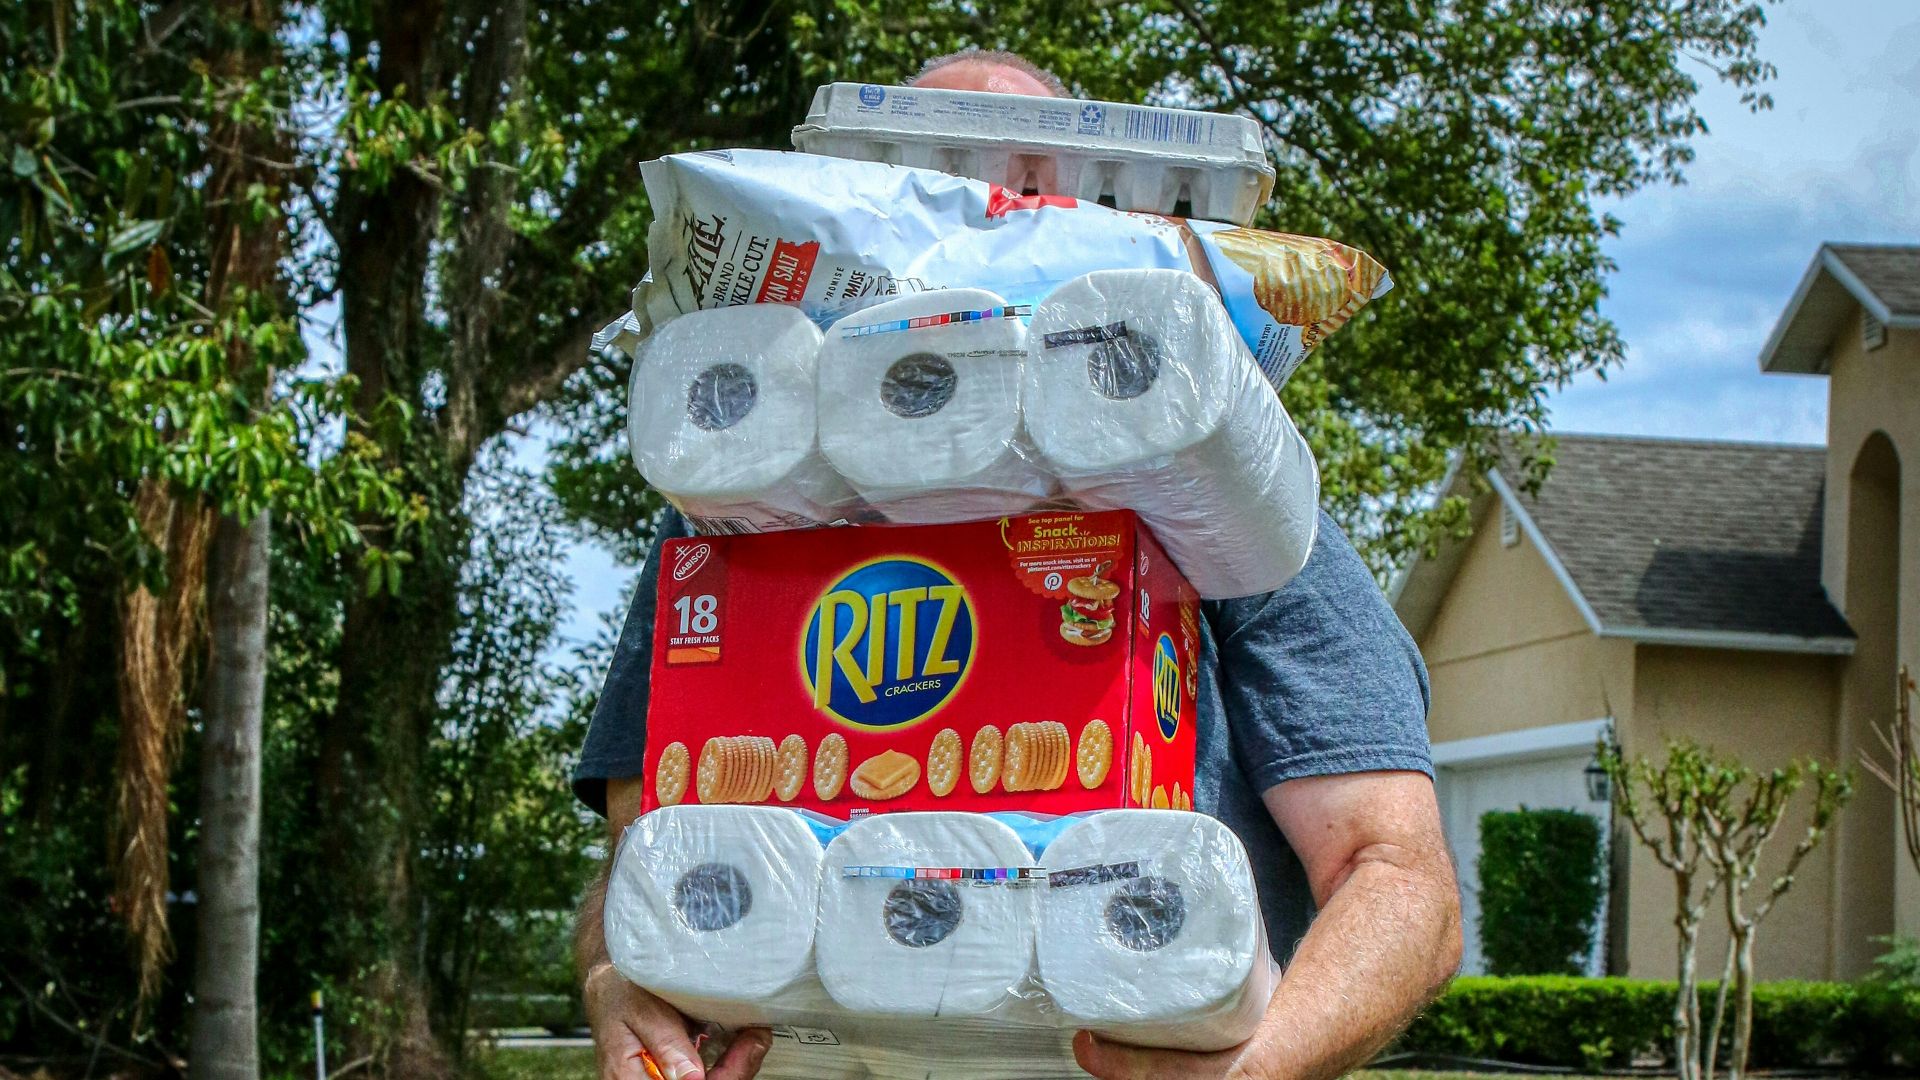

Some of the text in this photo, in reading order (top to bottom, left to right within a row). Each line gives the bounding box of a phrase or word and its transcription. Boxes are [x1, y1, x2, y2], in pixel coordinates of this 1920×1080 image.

[712, 262, 735, 302] BRAND
[773, 252, 799, 281] SALT
[791, 270, 807, 300] CHIPS
[824, 267, 844, 303] PROMISE
[1034, 523, 1078, 538] Snack
[1054, 515, 1073, 523] panel
[1017, 534, 1120, 552] INSPIRATIONS!
[675, 546, 707, 578] NABISCO
[674, 594, 718, 634] 18
[1140, 588, 1150, 620] 18
[670, 635, 720, 645] STAY FRESH PACKS
[814, 585, 965, 710] RITZ
[885, 679, 941, 697] CRACKERS
[1154, 643, 1180, 721] RITZ
